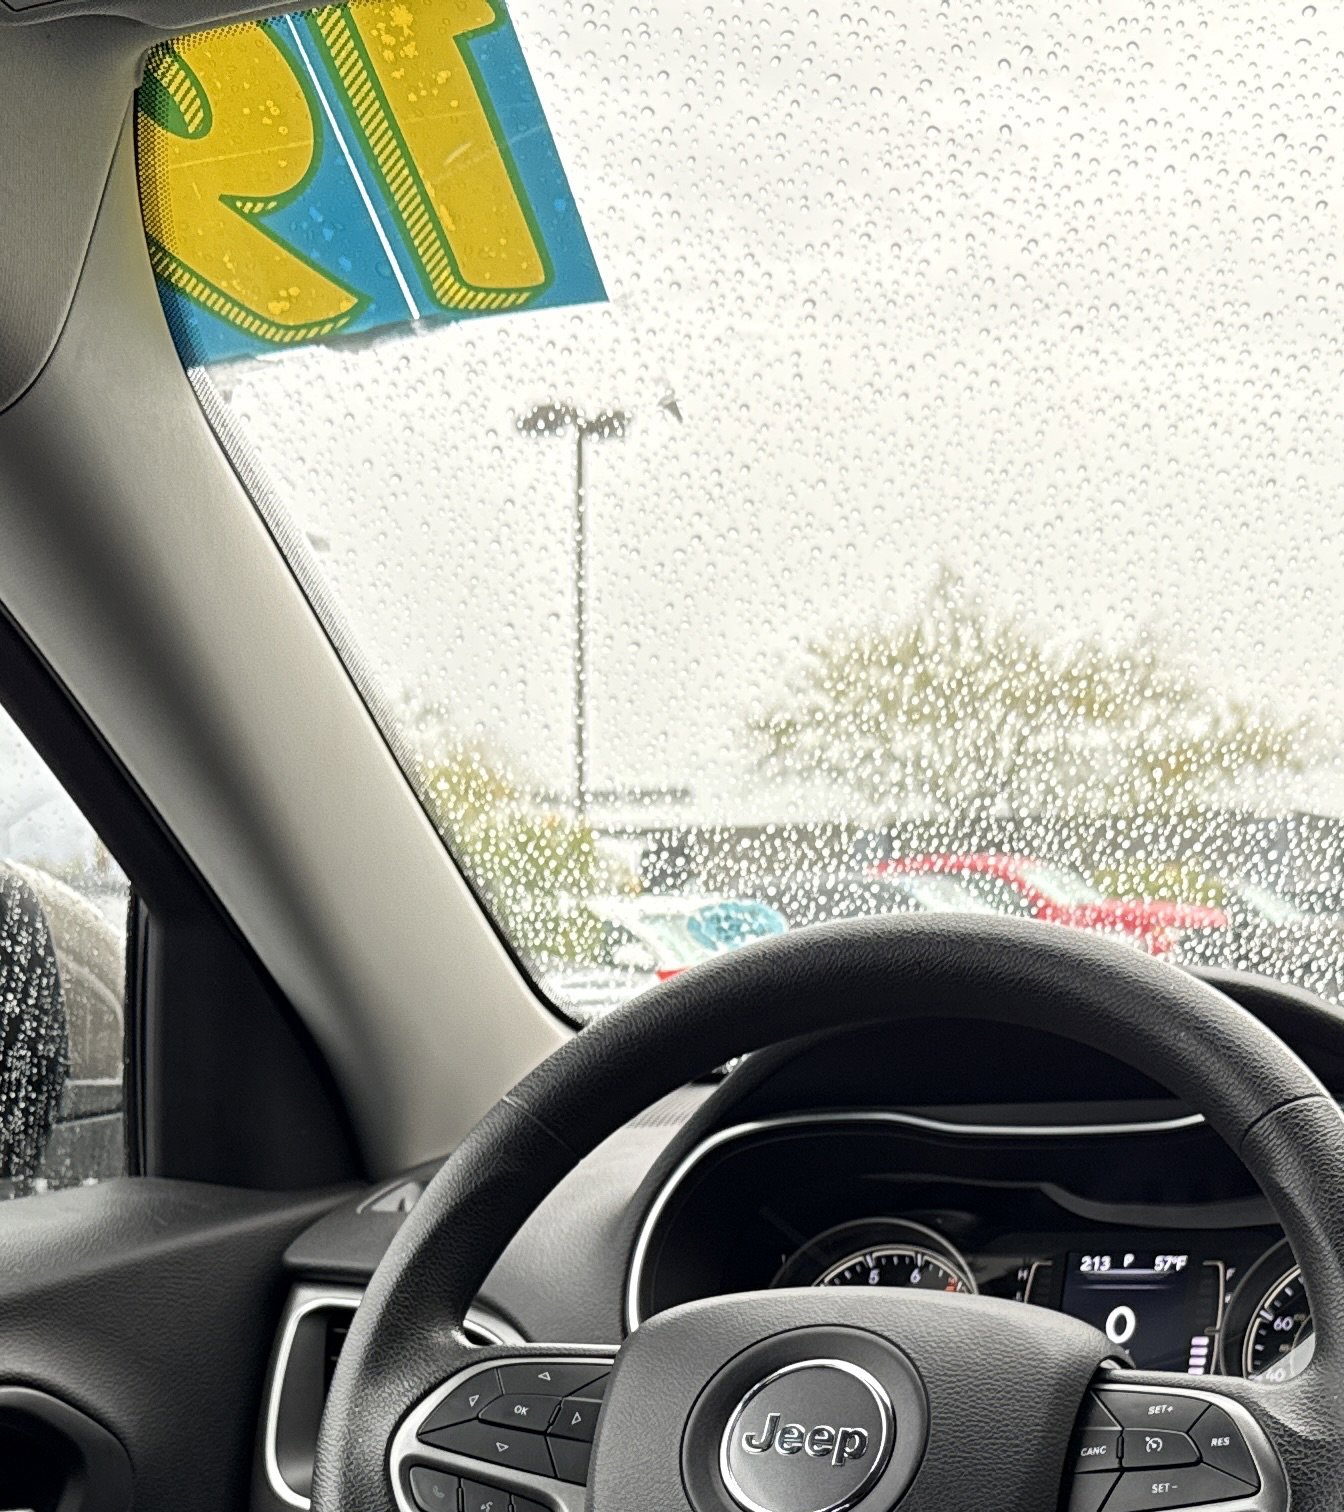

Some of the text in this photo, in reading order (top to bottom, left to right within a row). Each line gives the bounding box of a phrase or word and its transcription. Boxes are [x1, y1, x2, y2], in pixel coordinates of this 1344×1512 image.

[1123, 1253, 1135, 1268] P
[868, 1268, 880, 1285] 5
[910, 1268, 921, 1284] 6
[1105, 1305, 1136, 1344] 0
[1273, 1316, 1294, 1332] 60
[514, 1404, 529, 1416] OK
[741, 1412, 869, 1467] Jeep
[1210, 1436, 1231, 1447] RES
[1080, 1445, 1107, 1457] CANC
